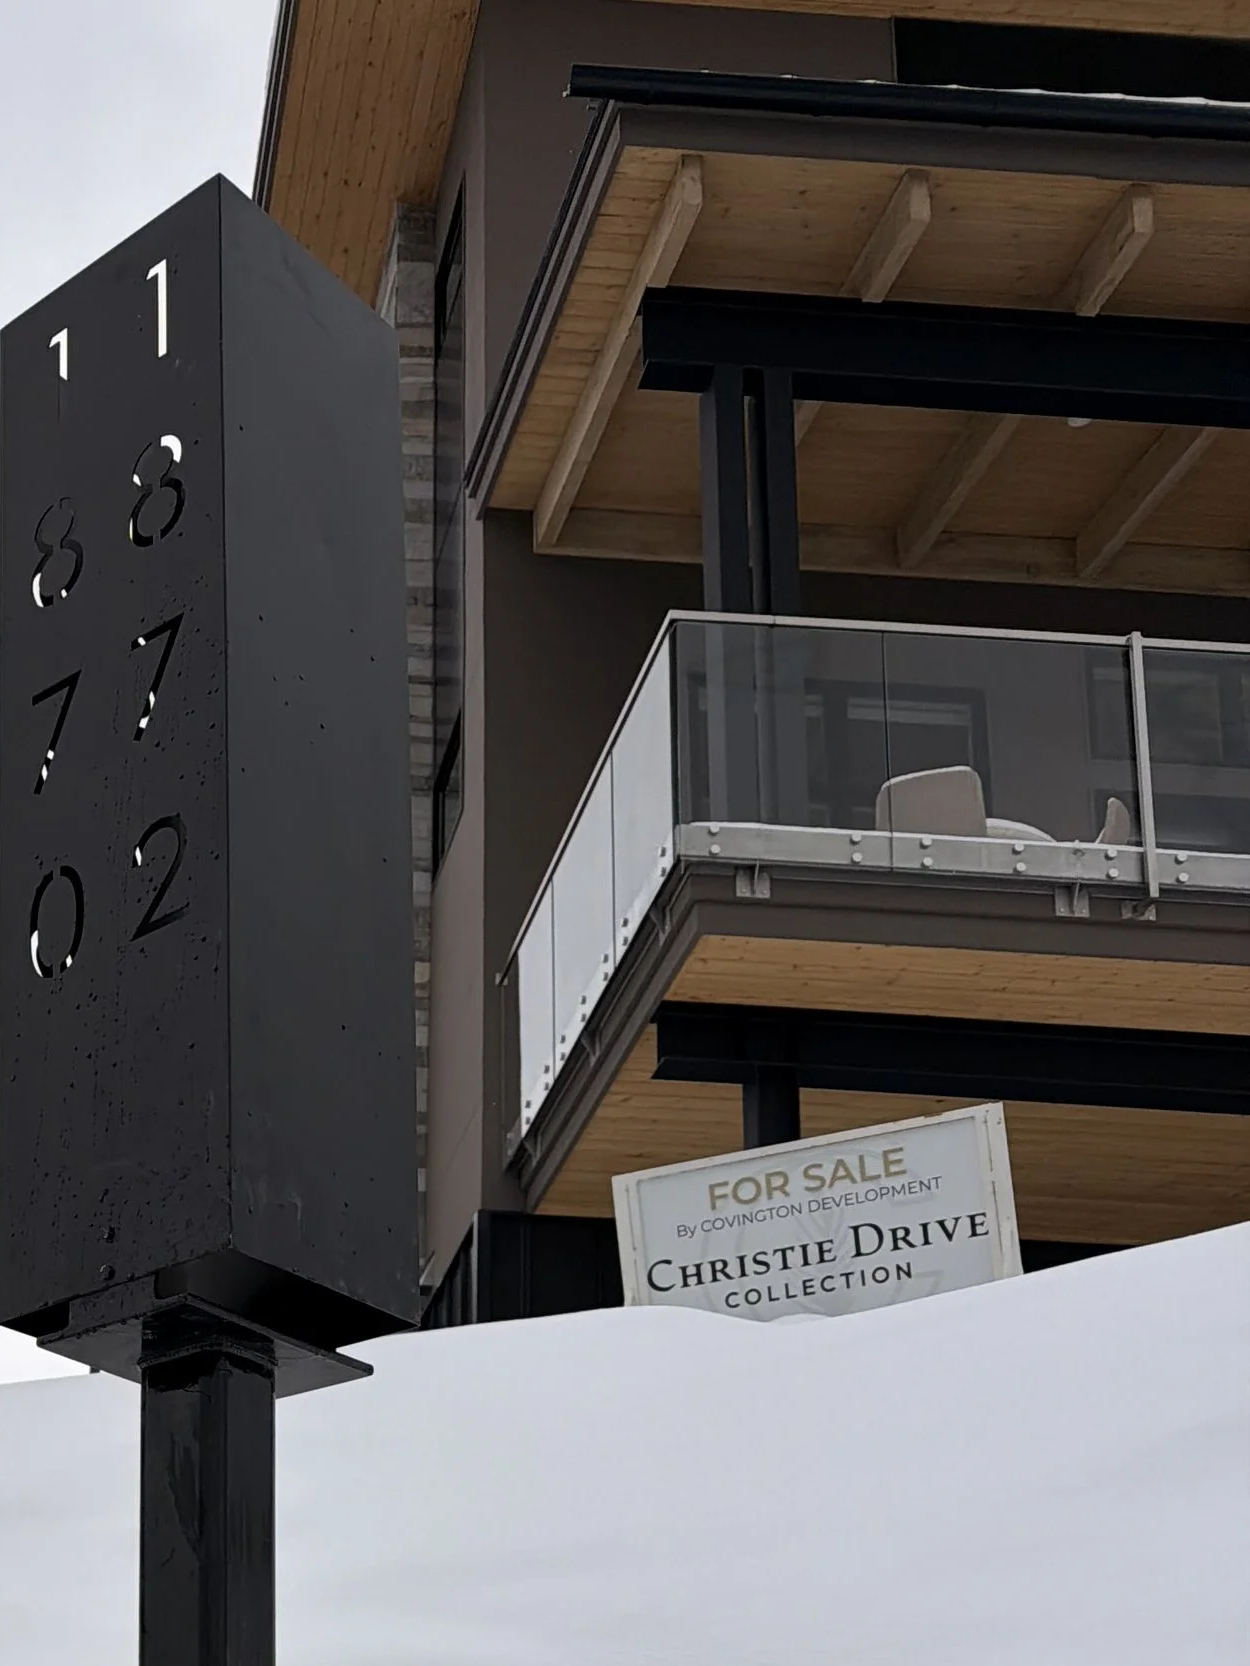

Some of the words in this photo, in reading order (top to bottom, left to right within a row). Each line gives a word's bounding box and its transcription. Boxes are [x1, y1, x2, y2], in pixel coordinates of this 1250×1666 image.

[676, 1223, 698, 1239] By
[700, 1202, 803, 1233] COVINGTON
[808, 1176, 943, 1213] DEVELOPMENT
[707, 1170, 791, 1211] FOR
[802, 1146, 908, 1193] SALE
[646, 1239, 838, 1293] CHRISTIE
[849, 1212, 990, 1259] DRIVE
[725, 1262, 914, 1309] COLLECTION
